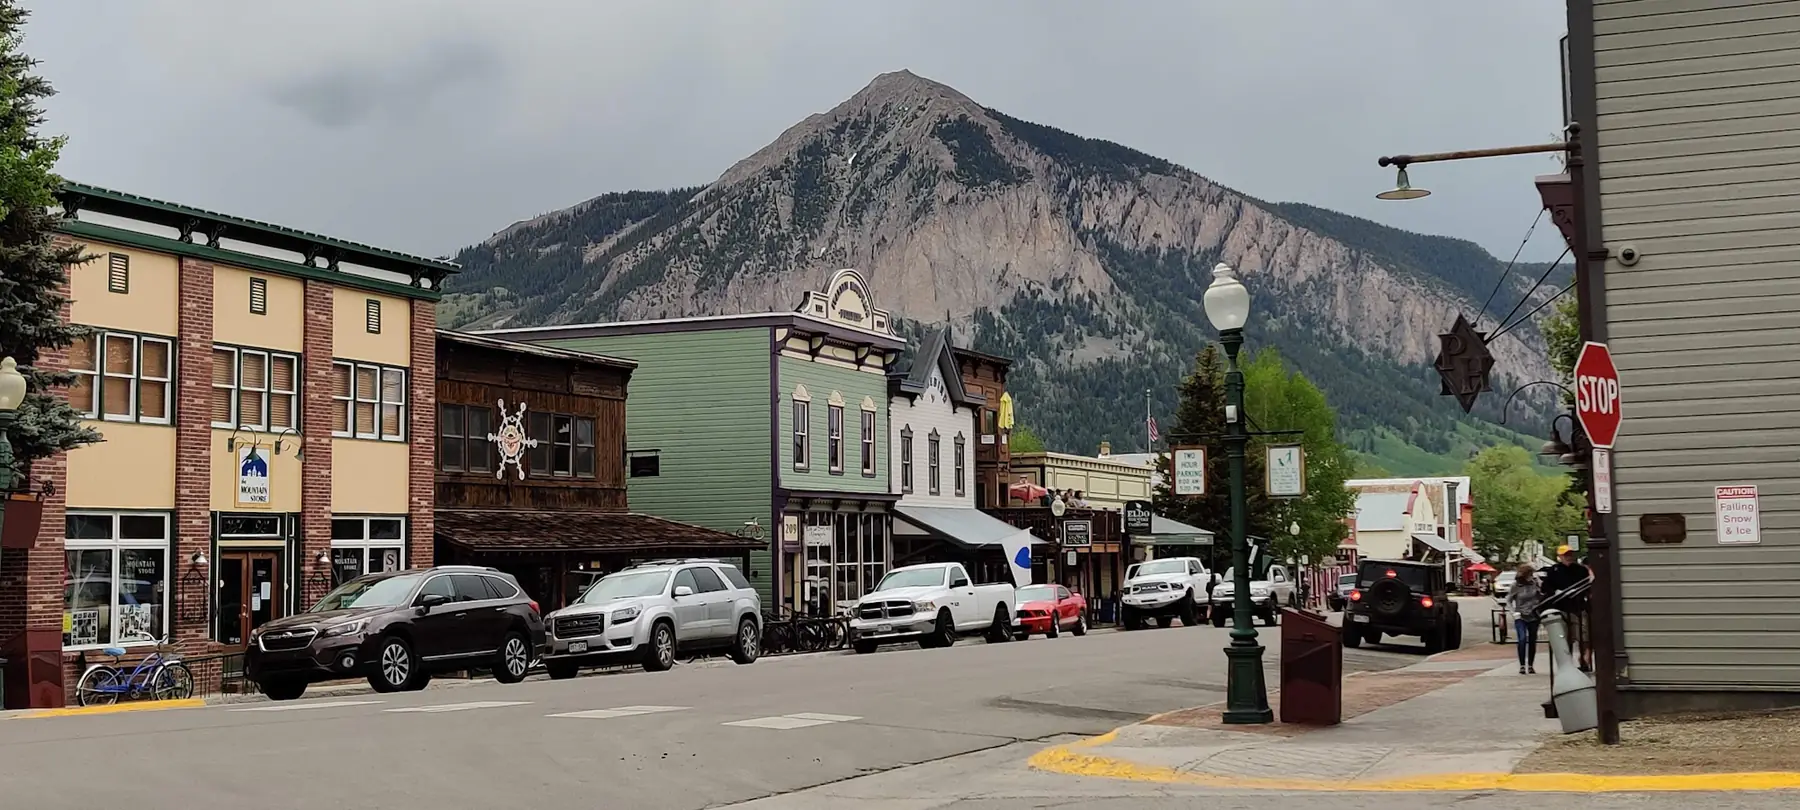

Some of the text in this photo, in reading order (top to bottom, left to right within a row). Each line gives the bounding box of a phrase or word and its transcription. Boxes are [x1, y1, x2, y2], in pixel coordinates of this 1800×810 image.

[1579, 374, 1618, 415] STOP
[1183, 452, 1196, 460] TWO
[1180, 461, 1198, 469] HOUR
[240, 485, 268, 494] MOUNTAIN
[1720, 502, 1754, 513] Falling
[1127, 509, 1150, 518] ELDO
[1723, 514, 1753, 523] Snow
[785, 523, 797, 534] 209
[1725, 526, 1752, 535] & Ice
